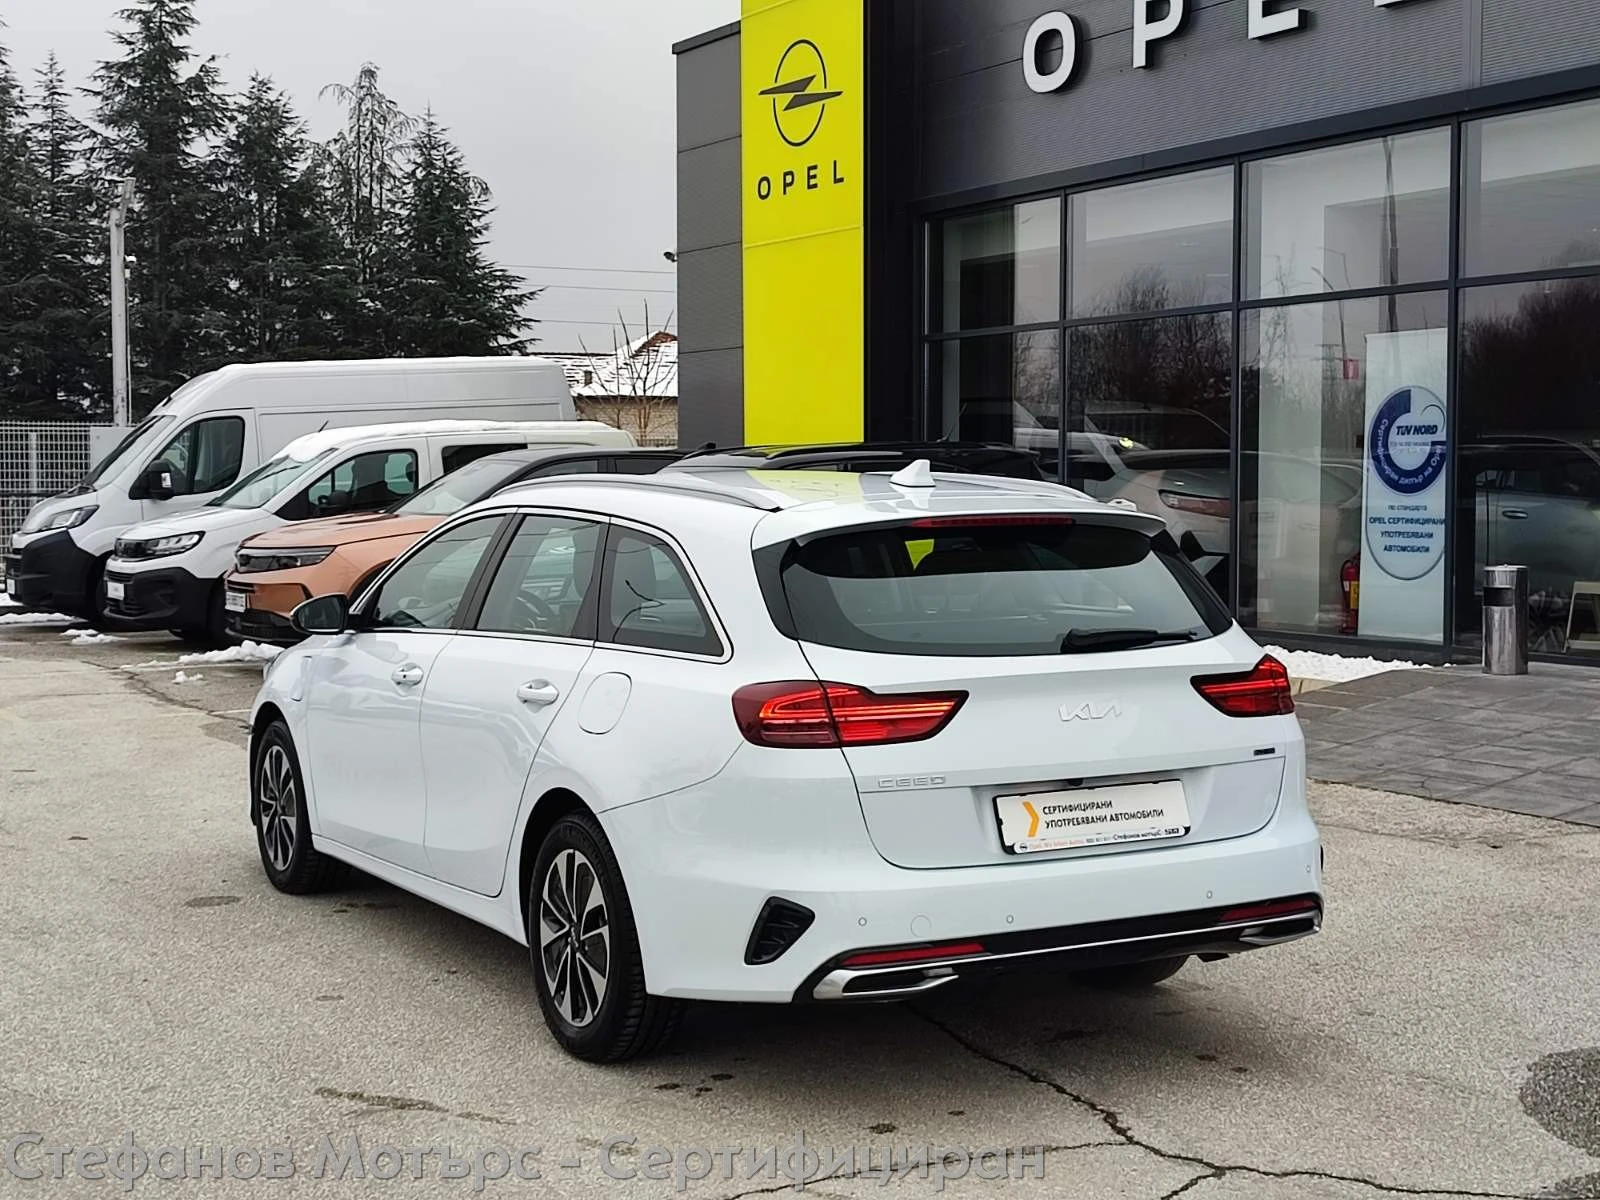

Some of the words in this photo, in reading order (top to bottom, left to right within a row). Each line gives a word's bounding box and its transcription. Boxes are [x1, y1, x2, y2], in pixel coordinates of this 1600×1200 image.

[1023, 0, 1404, 93] OP
[757, 159, 845, 201] OPEL
[1412, 425, 1438, 435] NORD
[1388, 517, 1445, 526] СЕРТИФИЦИРАНИ
[1380, 531, 1433, 539] УПОТРЕБЯВАНИ
[1384, 544, 1430, 552] АВТОМОБИЛИ
[878, 775, 945, 789] CEED
[1042, 800, 1113, 815] СЕРТИФИЦИРАНИ
[1045, 814, 1107, 829] УПОТРЕБЯВАНИ
[1109, 809, 1164, 822] АВТОМОБИЛИ
